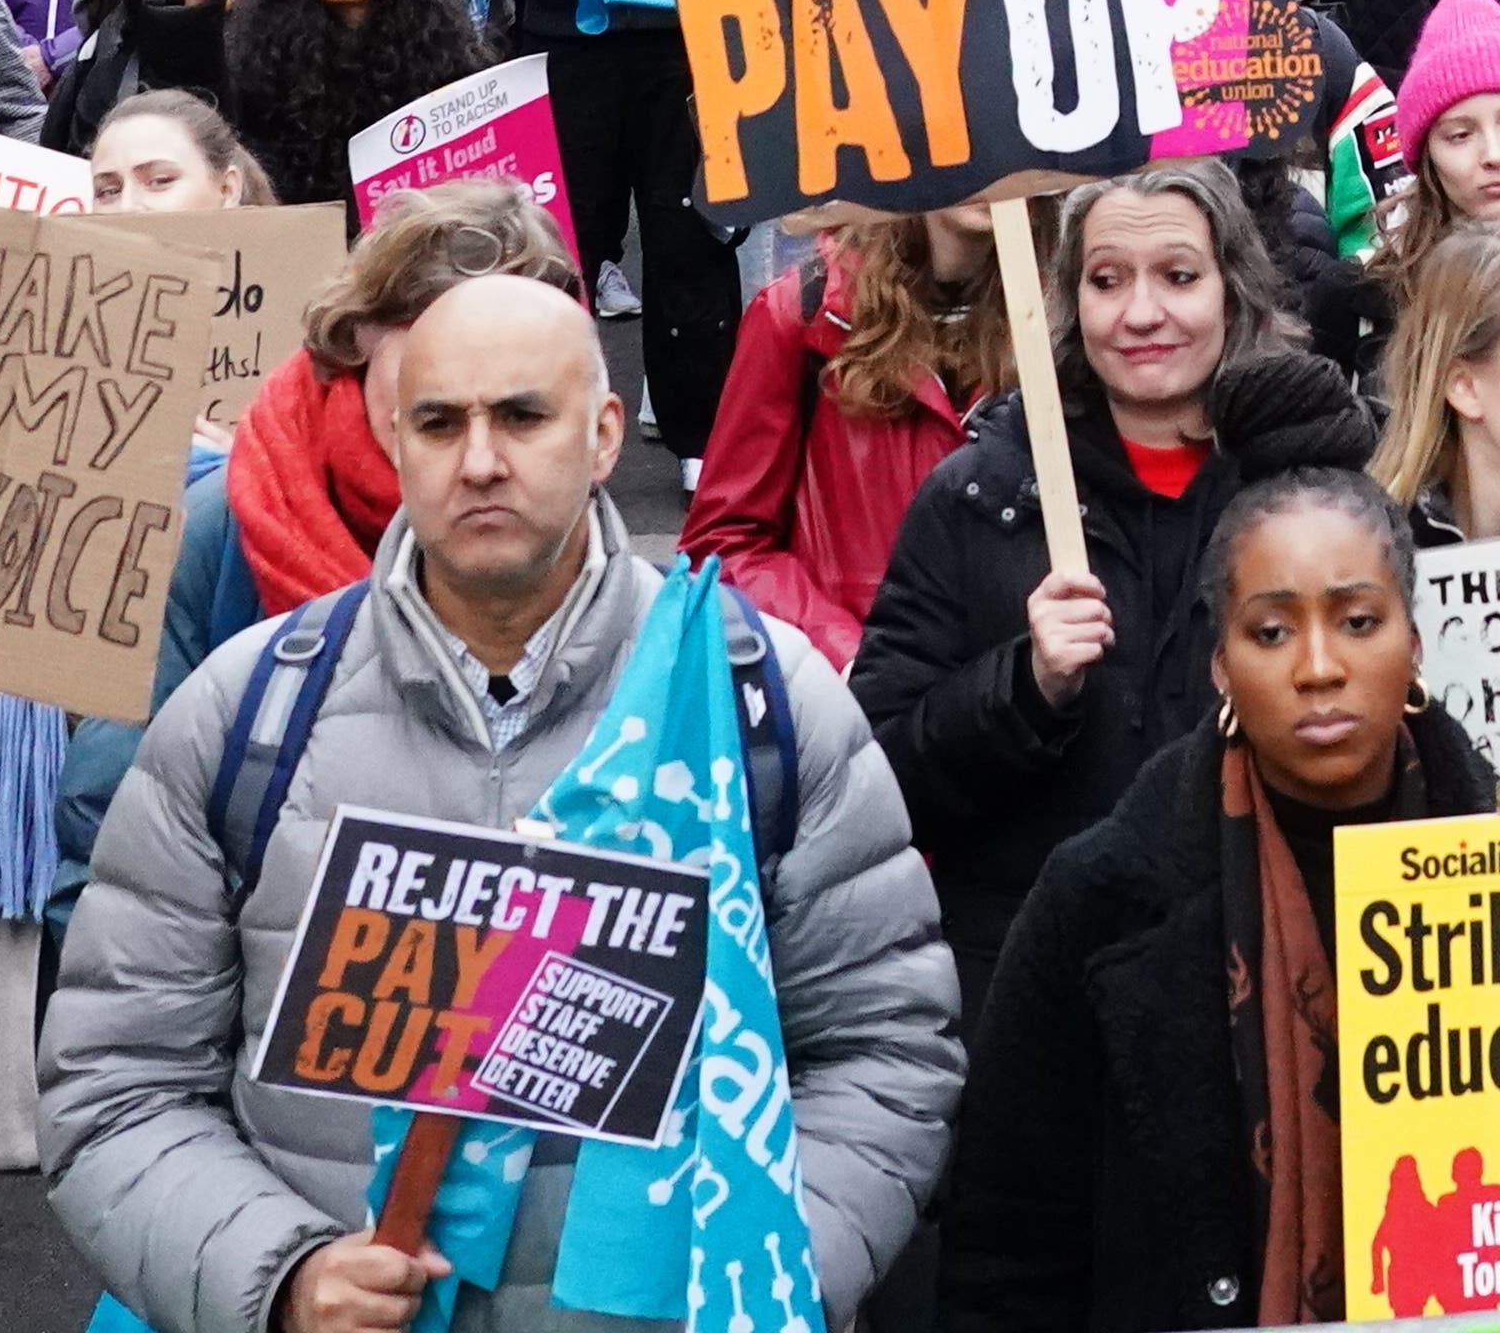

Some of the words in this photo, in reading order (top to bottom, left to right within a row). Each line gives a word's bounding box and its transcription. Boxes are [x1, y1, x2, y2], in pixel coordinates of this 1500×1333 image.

[1172, 50, 1321, 81] education
[1209, 31, 1283, 51] national
[1221, 81, 1274, 100] union
[345, 841, 573, 939] REJECT
[581, 883, 694, 957] THE
[318, 907, 512, 1008] PAY
[518, 995, 605, 1044] STAFF
[537, 961, 658, 1029] SUPPORT
[293, 992, 493, 1099] CUT
[502, 1029, 617, 1090] DESERVE
[482, 1058, 580, 1114] BETTER
